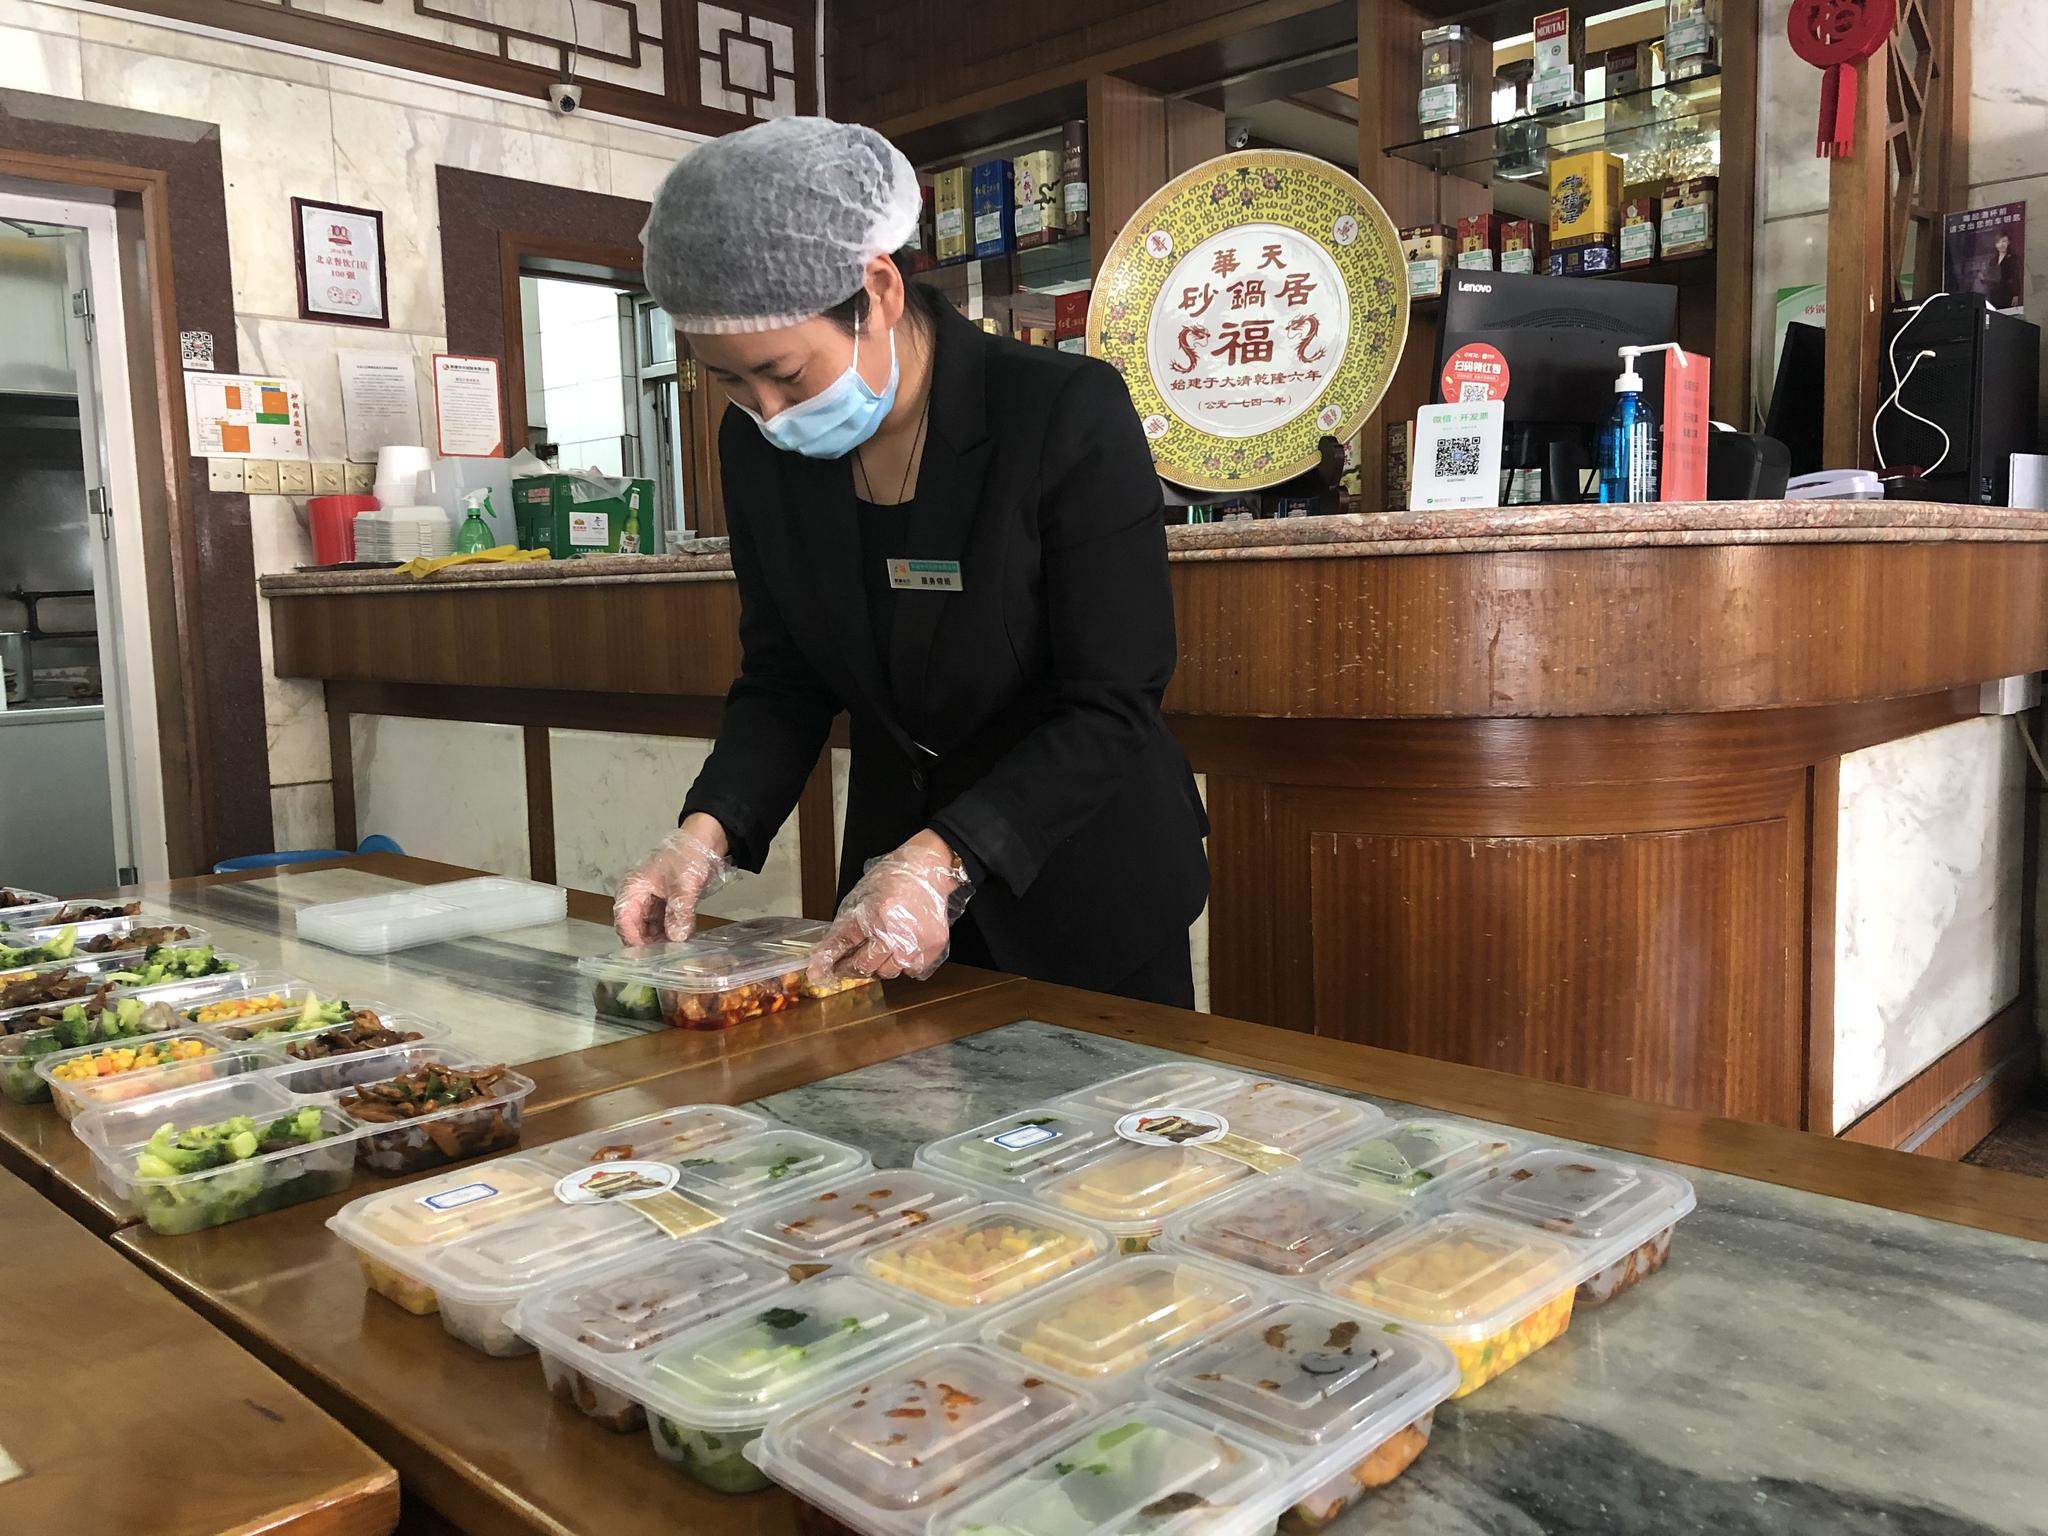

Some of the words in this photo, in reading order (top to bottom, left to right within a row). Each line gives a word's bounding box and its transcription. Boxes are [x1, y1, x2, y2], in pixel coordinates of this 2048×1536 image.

[1537, 21, 1566, 38] MOUTAI
[1178, 272, 1317, 318] 砂鍋居
[1458, 280, 1492, 293] Lenovo
[1211, 319, 1275, 366] 福
[1454, 359, 1502, 375] 扫码领红包
[1170, 370, 1322, 391] 始建于大清乾隆六年
